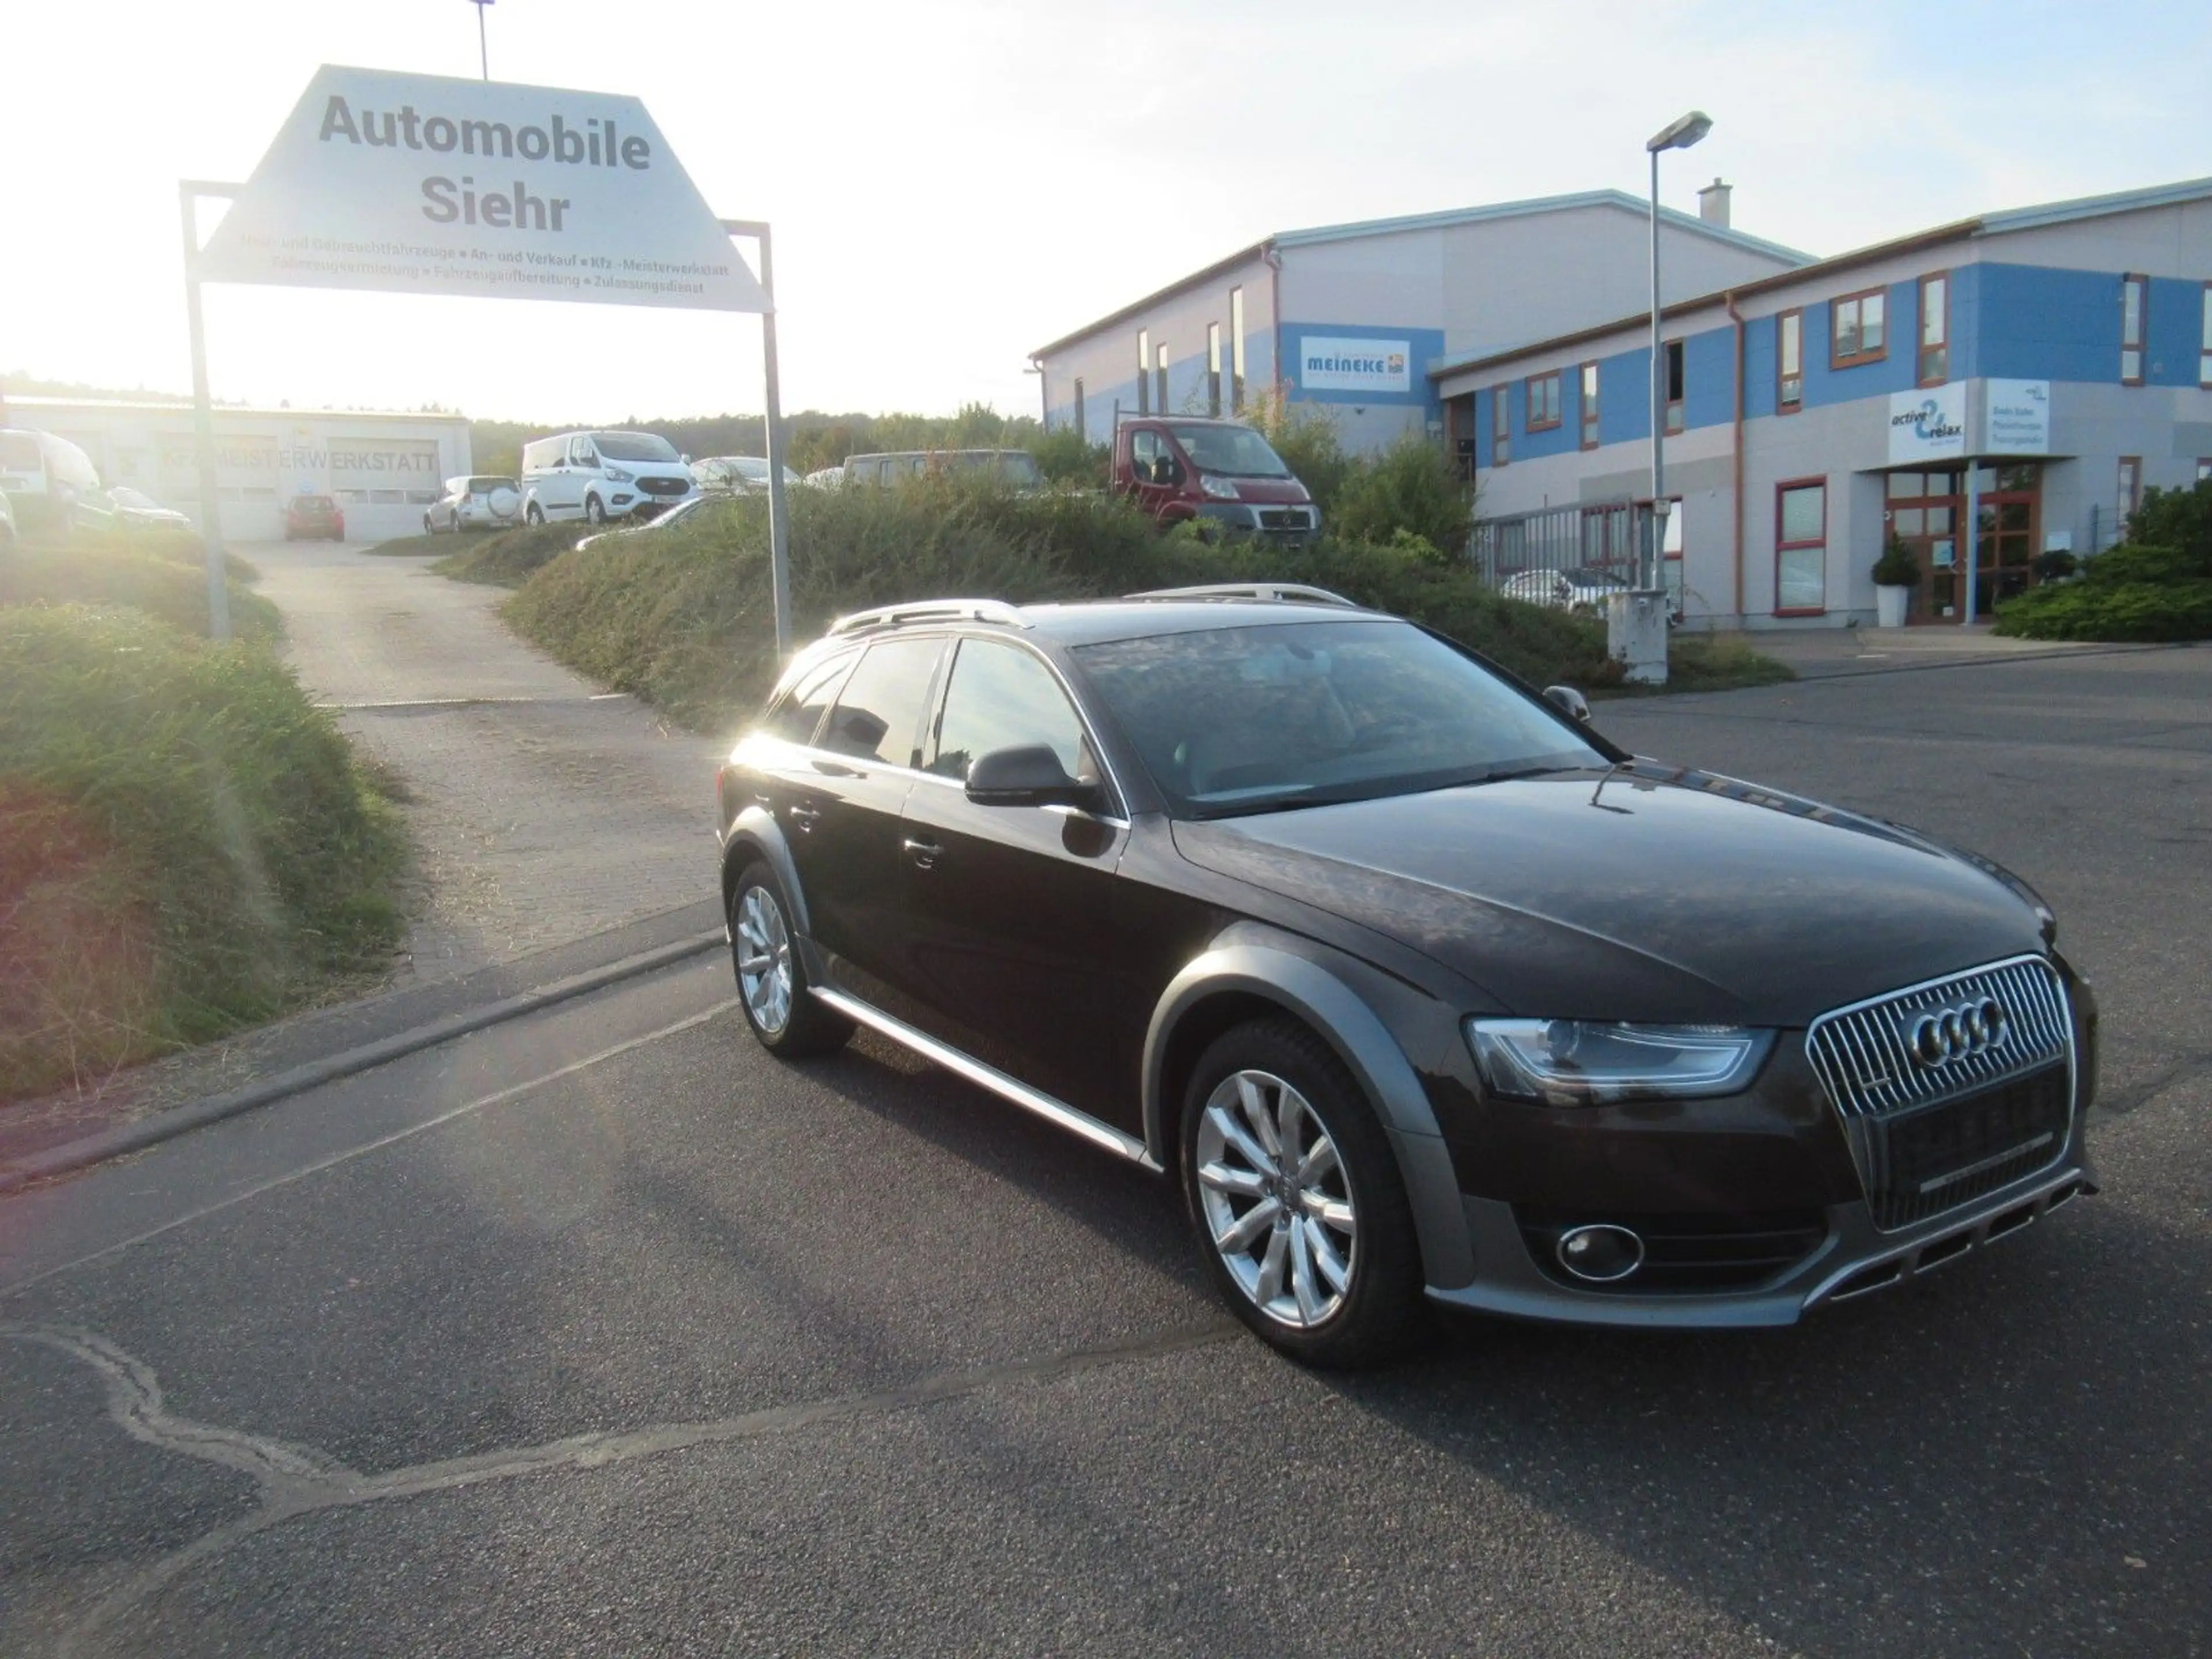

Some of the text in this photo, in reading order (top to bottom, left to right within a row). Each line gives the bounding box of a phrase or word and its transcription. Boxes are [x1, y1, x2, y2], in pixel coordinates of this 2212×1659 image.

[319, 94, 650, 170] Automobile
[421, 175, 570, 232] Siehr
[312, 236, 456, 259] Gebrauchtfahrzeuge
[497, 251, 522, 264] und
[526, 252, 577, 267] Verkauf
[434, 263, 580, 288] Fahrzeugaufbereitung
[593, 275, 704, 294] Zulassungsdienst
[1891, 410, 1928, 426] active
[1930, 423, 1962, 439] relax
